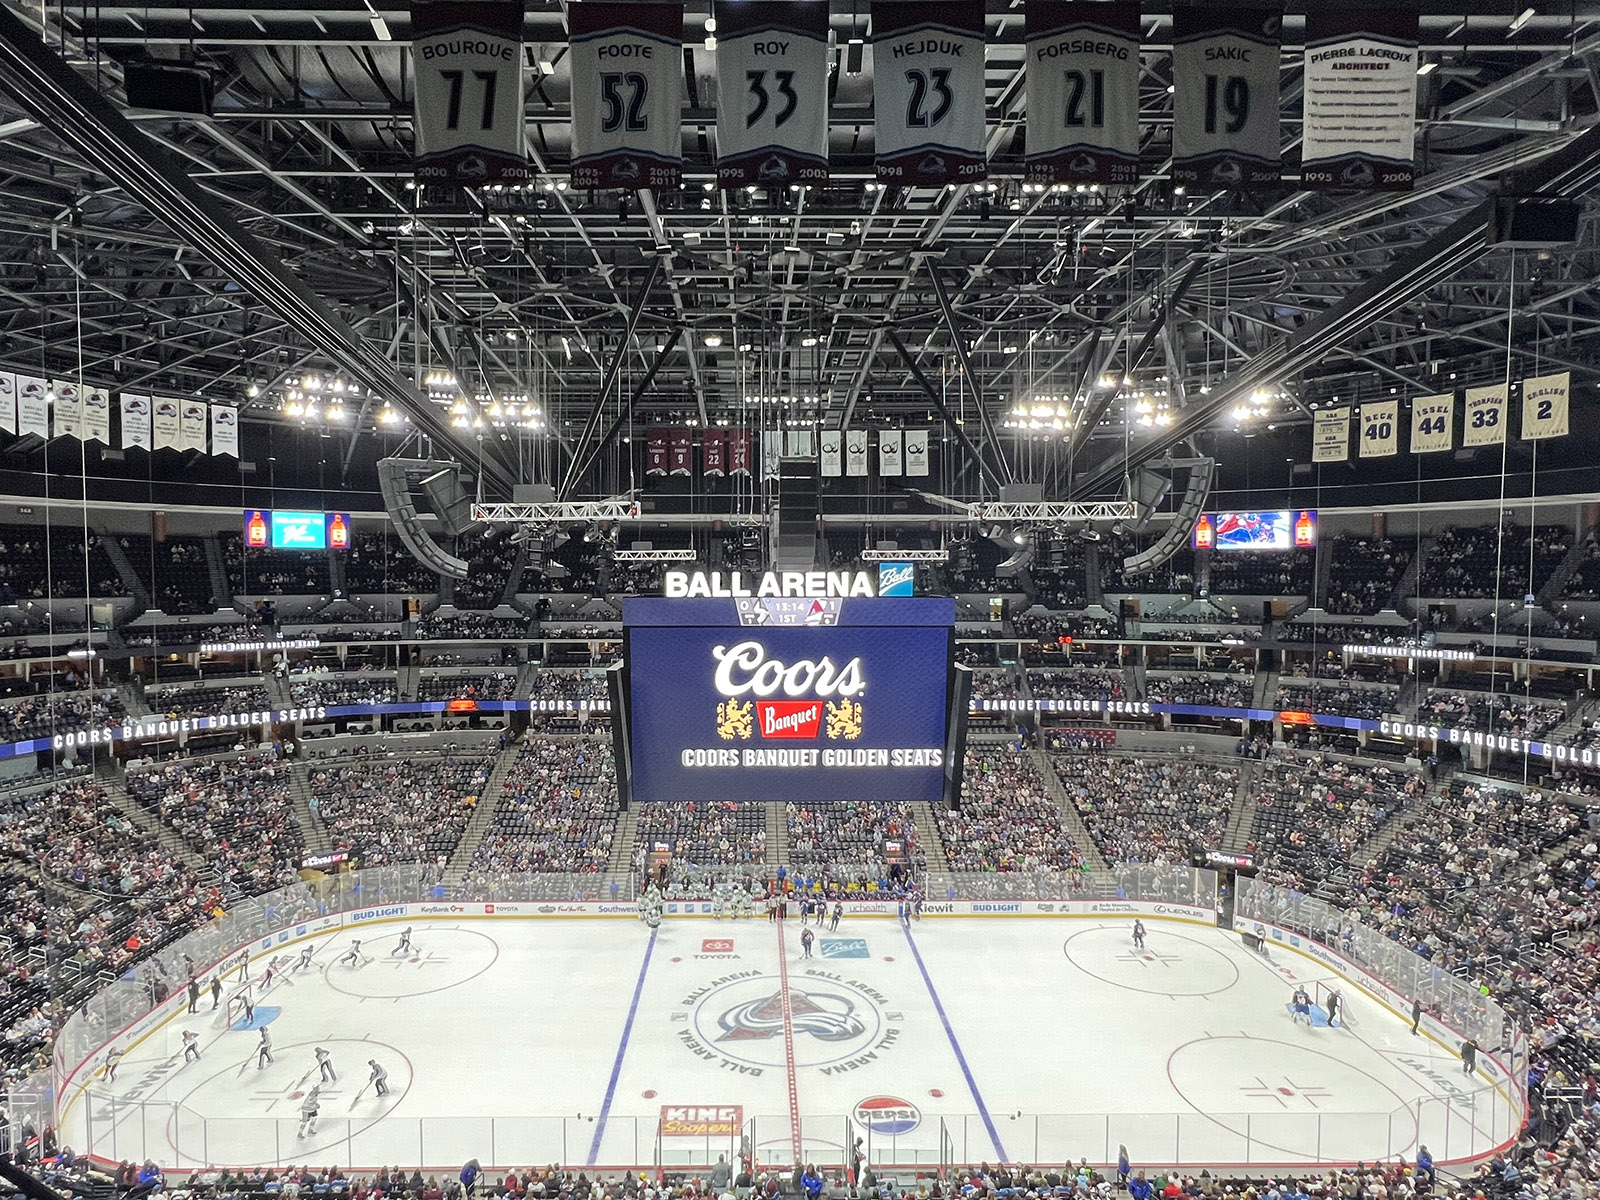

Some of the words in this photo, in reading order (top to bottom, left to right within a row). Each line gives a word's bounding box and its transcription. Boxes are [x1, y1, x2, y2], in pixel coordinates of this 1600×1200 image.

[422, 41, 513, 60] BOURQUE
[598, 45, 652, 59] FOOTE
[753, 41, 790, 56] ROY
[892, 40, 963, 59] HEJDUK
[1036, 41, 1129, 61] FORSBERG
[1205, 48, 1252, 62] SAKIC
[1311, 48, 1356, 64] PIERRE
[1360, 48, 1412, 63] LACROIX
[1331, 62, 1391, 71] ARCHITECT
[439, 70, 497, 131] 77
[600, 71, 649, 133] 52
[745, 69, 799, 130] 33
[904, 67, 954, 128] 23
[1063, 69, 1104, 128] 21
[1204, 74, 1250, 134] 19
[418, 167, 448, 178] 2000
[500, 168, 530, 178] 2001
[719, 168, 745, 178] 1995
[799, 168, 828, 179] 2003
[876, 166, 903, 176] 1998
[958, 164, 986, 175] 2013
[1305, 172, 1333, 182] 1995
[1382, 172, 1412, 183] 2006
[1526, 388, 1566, 401] ENGLISH
[1365, 412, 1394, 423] BECK
[1417, 405, 1449, 417] ISSEL
[1536, 400, 1553, 420] 2
[1418, 417, 1446, 435] 44
[1471, 408, 1499, 429] 33
[1365, 422, 1392, 441] 40
[678, 454, 684, 464] 9
[708, 455, 720, 465] 22
[665, 571, 752, 598] BALL
[756, 571, 875, 598] ARENA
[880, 567, 914, 590] Ball
[740, 601, 749, 610] 0
[775, 602, 804, 611] 13:14
[829, 601, 835, 610] 1
[779, 614, 797, 624] 1ST
[712, 641, 866, 697] Coors
[530, 700, 573, 711] COORS
[983, 700, 1041, 711] BANQUET
[1048, 700, 1100, 713] GOLDEN
[1106, 701, 1150, 715] SEATS
[53, 727, 112, 748] COORS
[122, 718, 200, 738] BANQUET
[208, 711, 271, 729] GOLDEN
[279, 706, 327, 721] SEATS
[765, 705, 817, 734] Banquet
[1380, 720, 1439, 740] COORS
[1449, 728, 1531, 753] BANQUET
[681, 748, 740, 768] COORS
[742, 748, 820, 768] BANQUET
[821, 748, 889, 768] GOLDEN
[890, 748, 942, 768] SEATS
[353, 909, 374, 921] BUD
[375, 907, 405, 919] LIGHT
[421, 906, 449, 914] KeyBank
[849, 903, 887, 912] uchealth
[993, 904, 1020, 912] LIGHT
[1167, 908, 1204, 917] LEXUS
[821, 940, 866, 952] Ball
[1309, 945, 1343, 971] Southwest
[681, 985, 712, 1006] BALL
[710, 969, 763, 987] ARENA
[805, 968, 842, 981] BALL
[845, 979, 889, 1005] ARENA
[677, 1028, 718, 1060] ARENA
[875, 1028, 900, 1050] BALL
[719, 1058, 764, 1077] BALL
[819, 1051, 878, 1077] ARENA
[1396, 1057, 1475, 1109] JAMESON
[666, 1108, 737, 1121] KING
[858, 1110, 916, 1120] PEPSI
